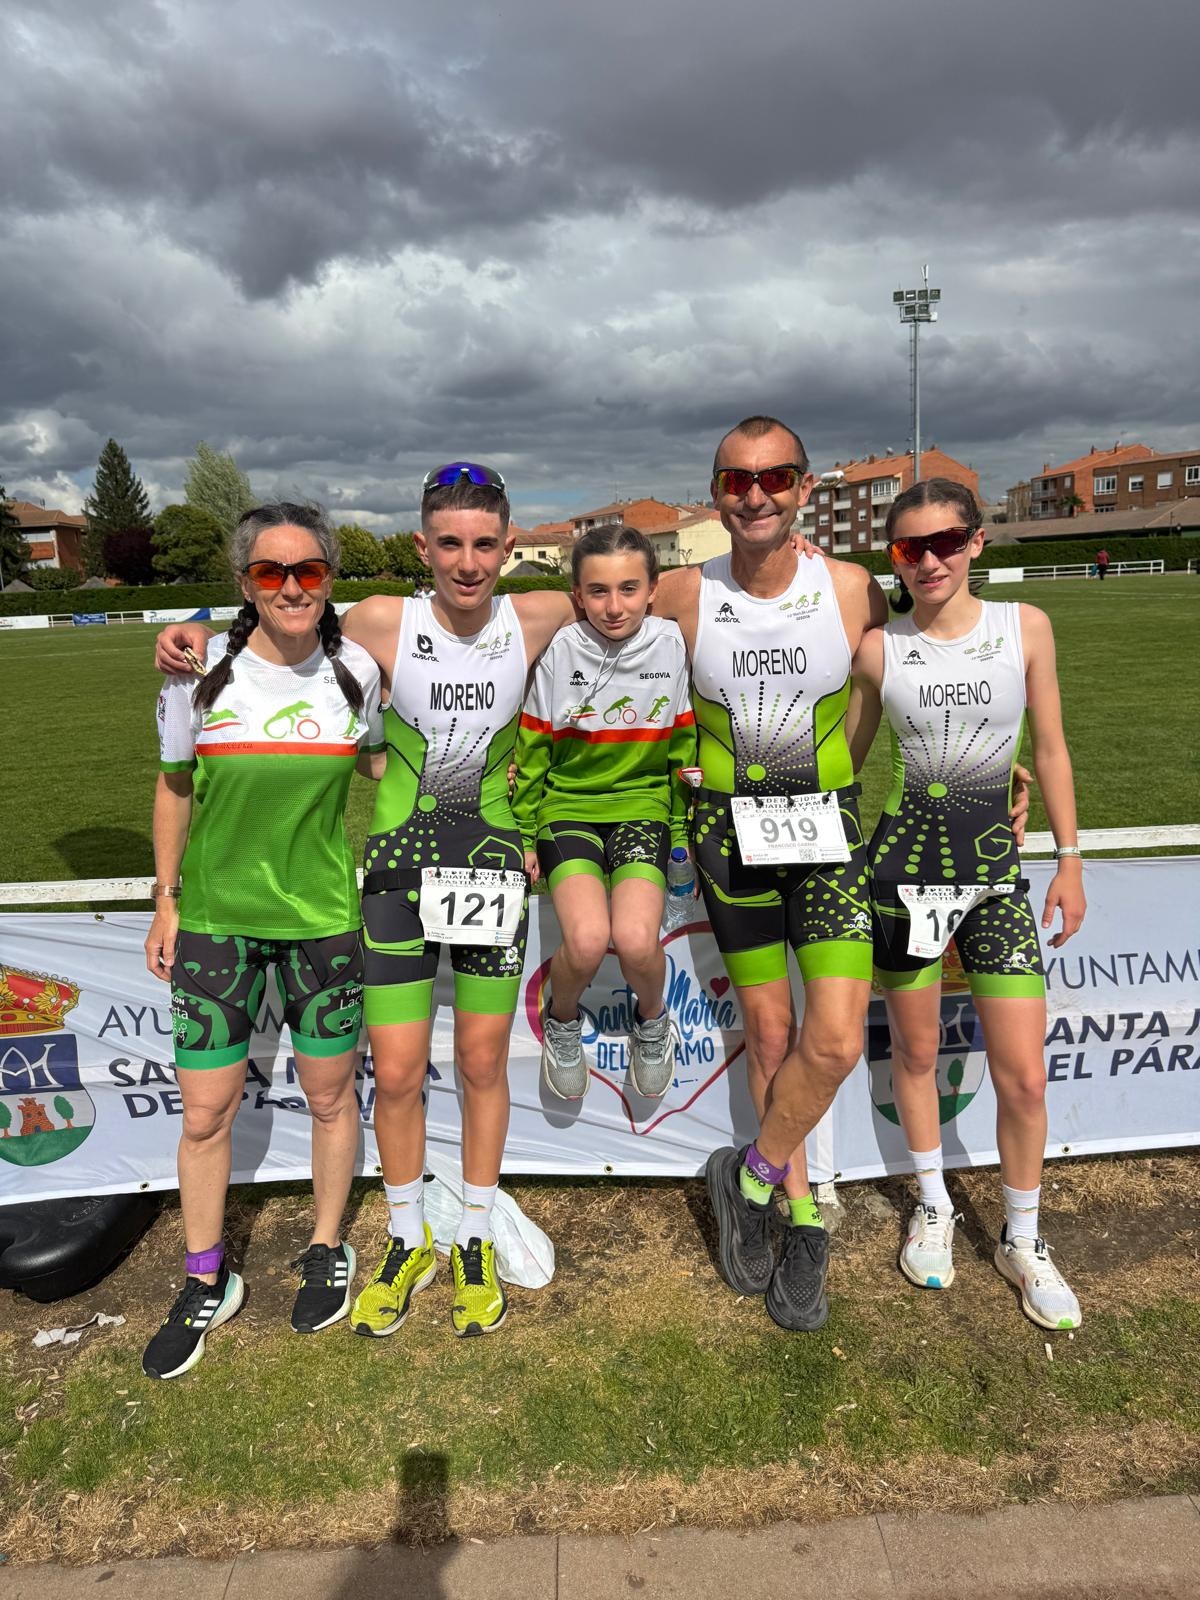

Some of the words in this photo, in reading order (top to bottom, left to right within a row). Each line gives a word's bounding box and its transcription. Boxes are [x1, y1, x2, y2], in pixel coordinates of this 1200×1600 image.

[639, 672, 671, 680] SEGOVIA
[732, 646, 807, 678] MORENO
[429, 681, 495, 711] MORENO
[919, 680, 991, 708] MORENO
[760, 818, 818, 843] 919
[441, 891, 505, 928] 121
[1044, 949, 1200, 990] YUNTAM
[581, 983, 637, 1045] Sant
[1044, 1010, 1170, 1047] ANTA
[597, 1042, 630, 1071] DEL
[674, 1036, 715, 1067] AMO
[1047, 1052, 1093, 1082] EL
